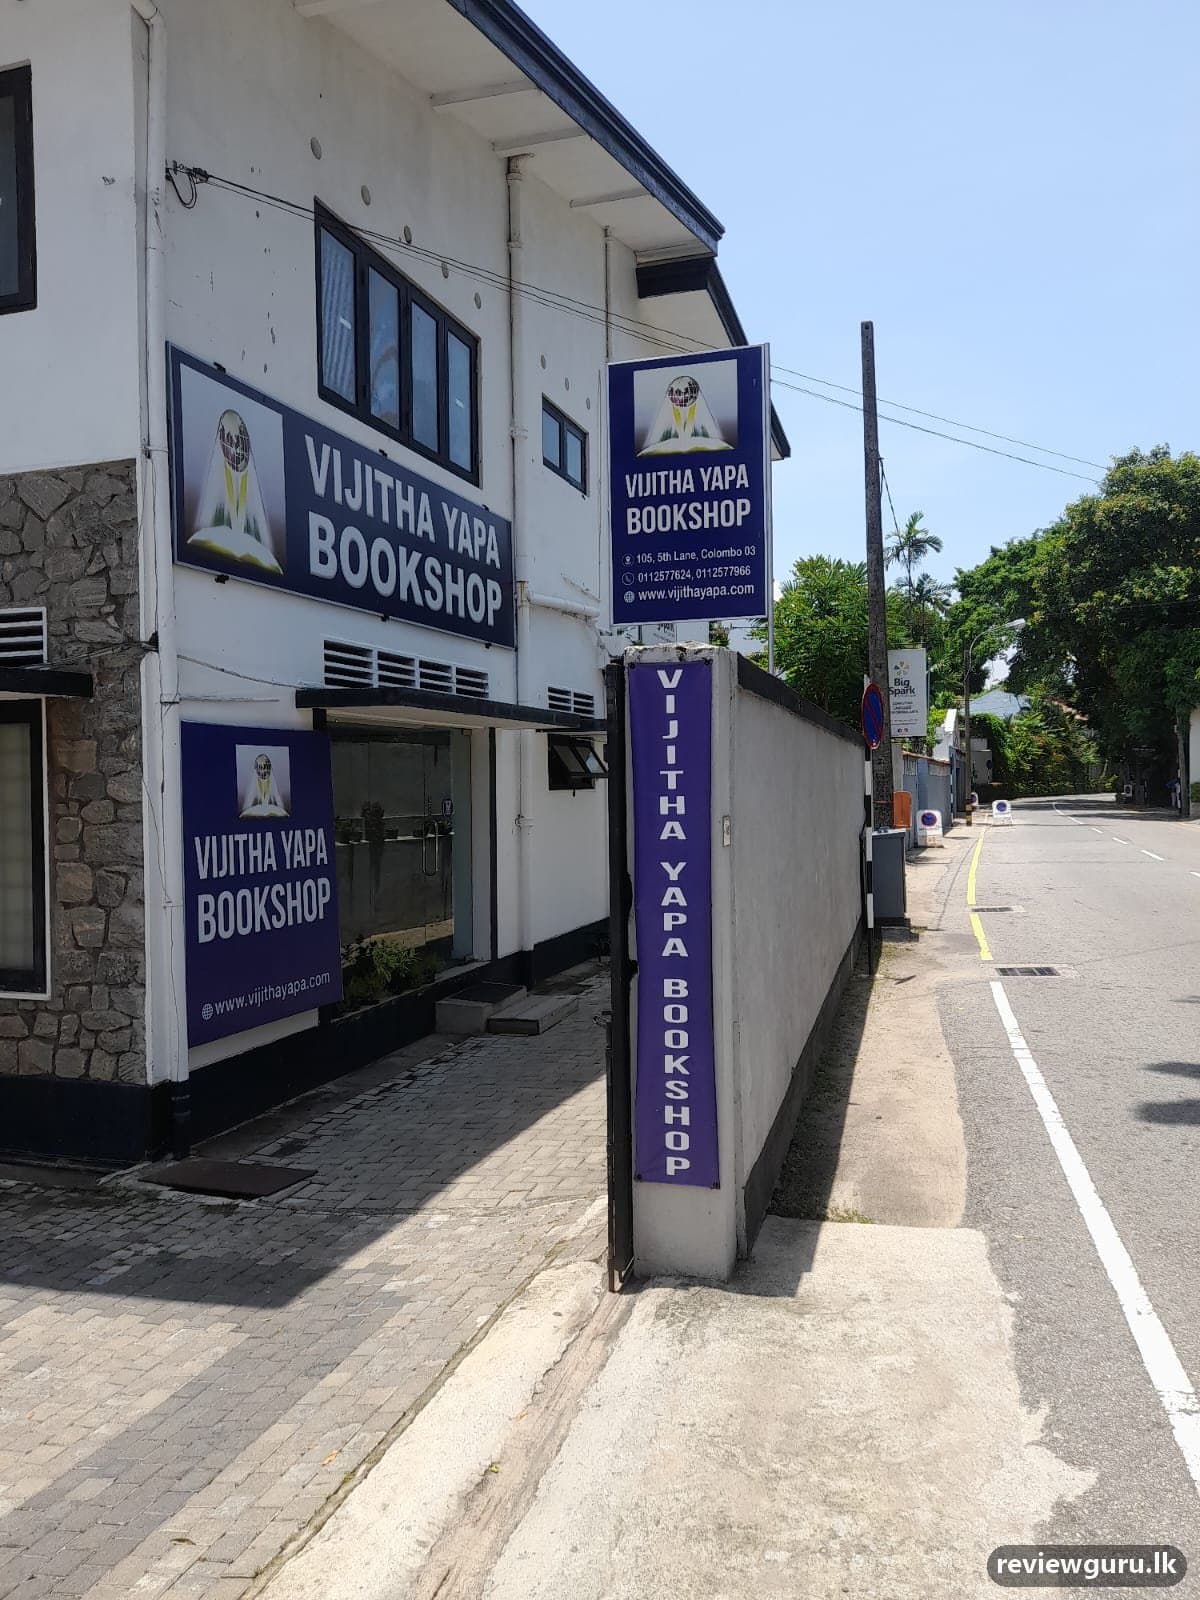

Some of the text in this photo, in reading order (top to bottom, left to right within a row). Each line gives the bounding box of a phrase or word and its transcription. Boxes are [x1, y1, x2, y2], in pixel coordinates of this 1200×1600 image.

[625, 463, 749, 498] VIJITHA YAPA
[305, 434, 501, 569] VIJITHA YAPA
[626, 498, 751, 535] BOOKSHOP
[308, 511, 502, 627] BOOKSHOP
[637, 545, 756, 564] 105, 5th Lane, Colombo 03
[638, 565, 751, 583] 0112577624, 0112577966
[638, 583, 755, 601] www.vijithayapa.com
[888, 685, 916, 697] Spark
[894, 678, 910, 688] Big
[194, 827, 329, 880] VIJITHA YAPA
[197, 877, 331, 944] BOOKSHOP
[657, 669, 690, 1176] VIJITHA YAPA BOOKSHOP
[215, 970, 331, 1016] www.vijithayapa.com
